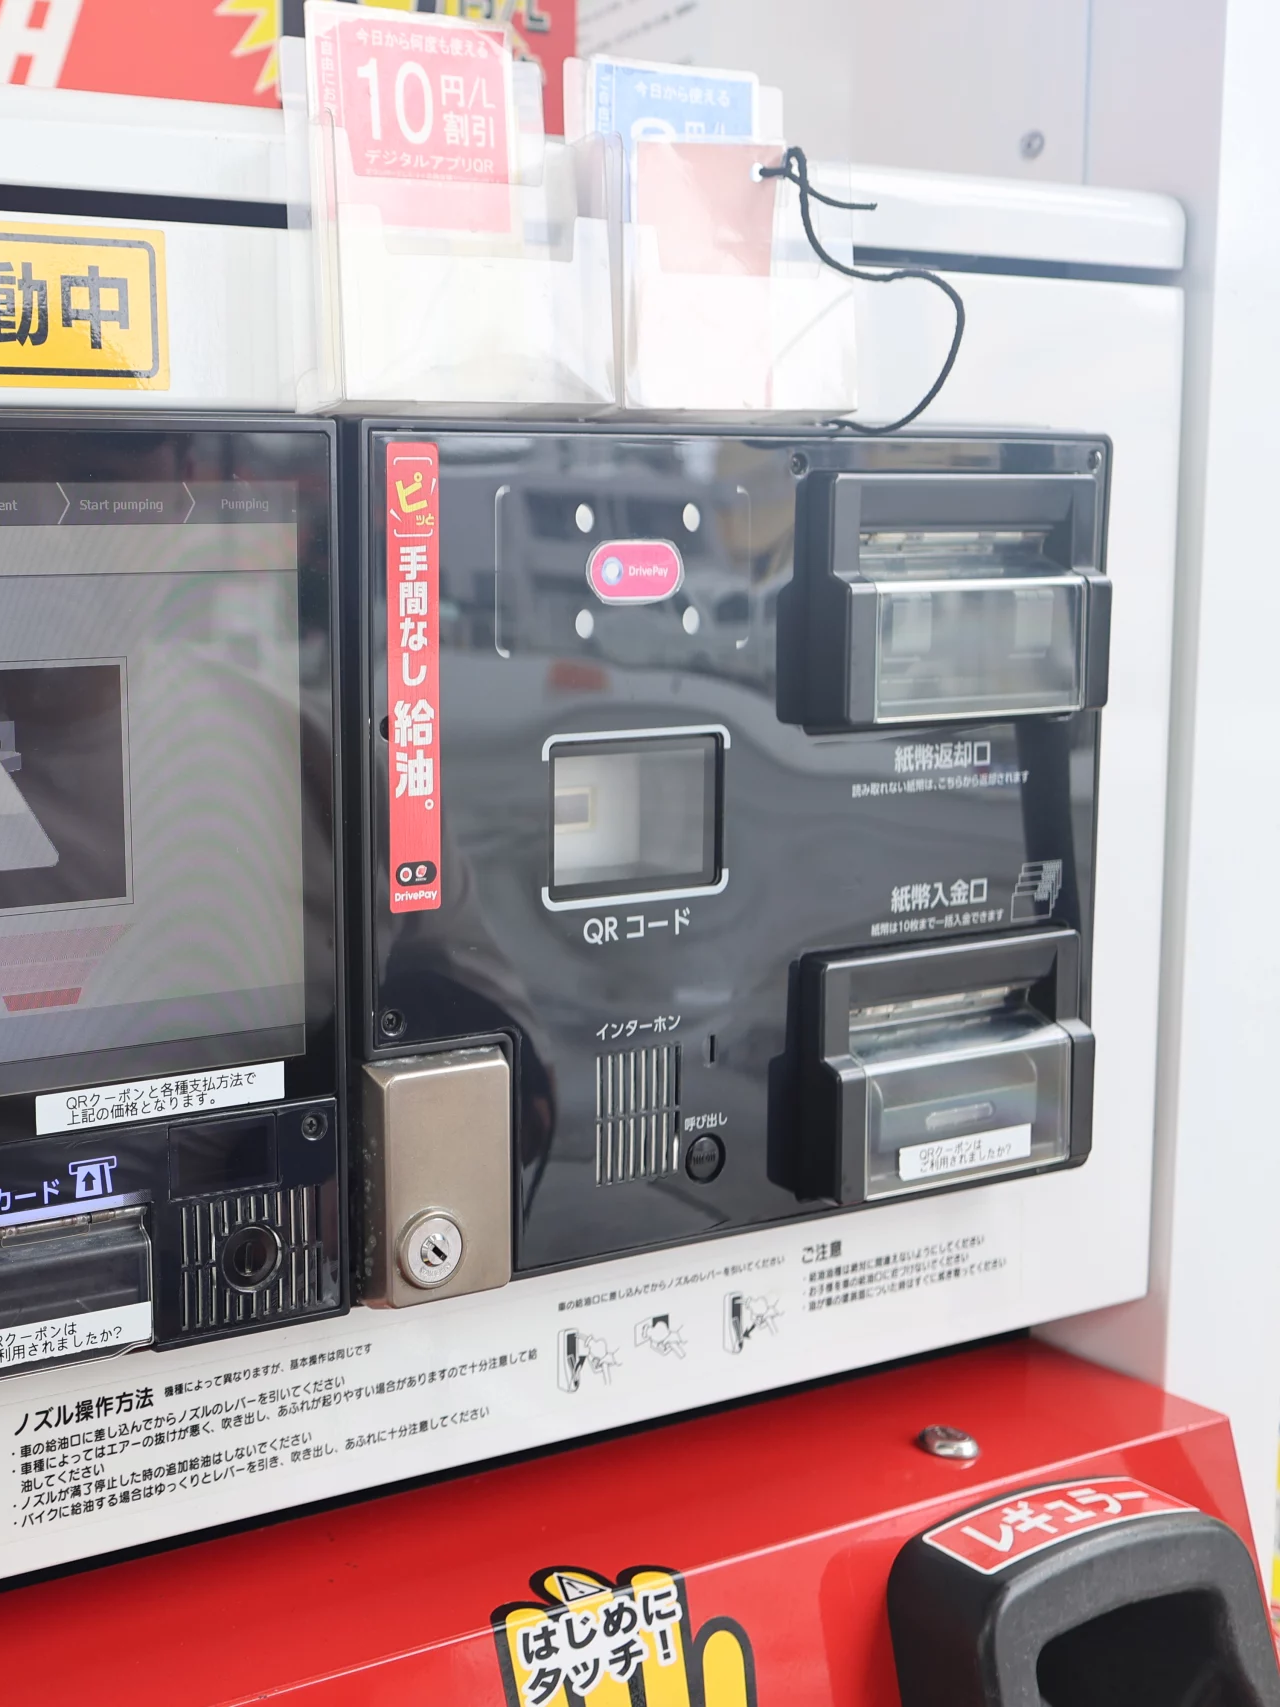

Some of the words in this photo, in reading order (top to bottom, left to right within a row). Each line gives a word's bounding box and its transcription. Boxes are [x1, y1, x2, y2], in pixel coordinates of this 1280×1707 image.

[355, 28, 490, 58] 今日から何度も使える
[357, 57, 434, 144] 10
[634, 80, 730, 107] 今日から使える
[443, 111, 495, 148] 割引
[365, 149, 494, 173] デジタルアプリQR
[80, 499, 110, 511] Start
[113, 499, 163, 513] pumping
[221, 498, 269, 513] Pumping
[628, 564, 669, 578] DrivePay
[893, 741, 991, 773] 紙幣返却口
[394, 889, 438, 903] DrivePay
[890, 878, 988, 913] 紙幣入金口
[596, 1015, 681, 1041] インターホン
[66, 1071, 257, 1111] QRクーポンと各種支払方法で
[66, 1092, 217, 1126] 上記の価格となります。
[684, 1112, 728, 1132] 呼び出し
[802, 1240, 842, 1264] ご注意
[14, 1387, 154, 1436] ノズル操作方法
[164, 1343, 373, 1397] 機種によって異なりますが、基本操作は同じです
[21, 1463, 105, 1494] 油してください
[961, 1487, 1150, 1553] レギュラー
[522, 1590, 677, 1664] はじめに
[527, 1630, 672, 1705] タッチ!
